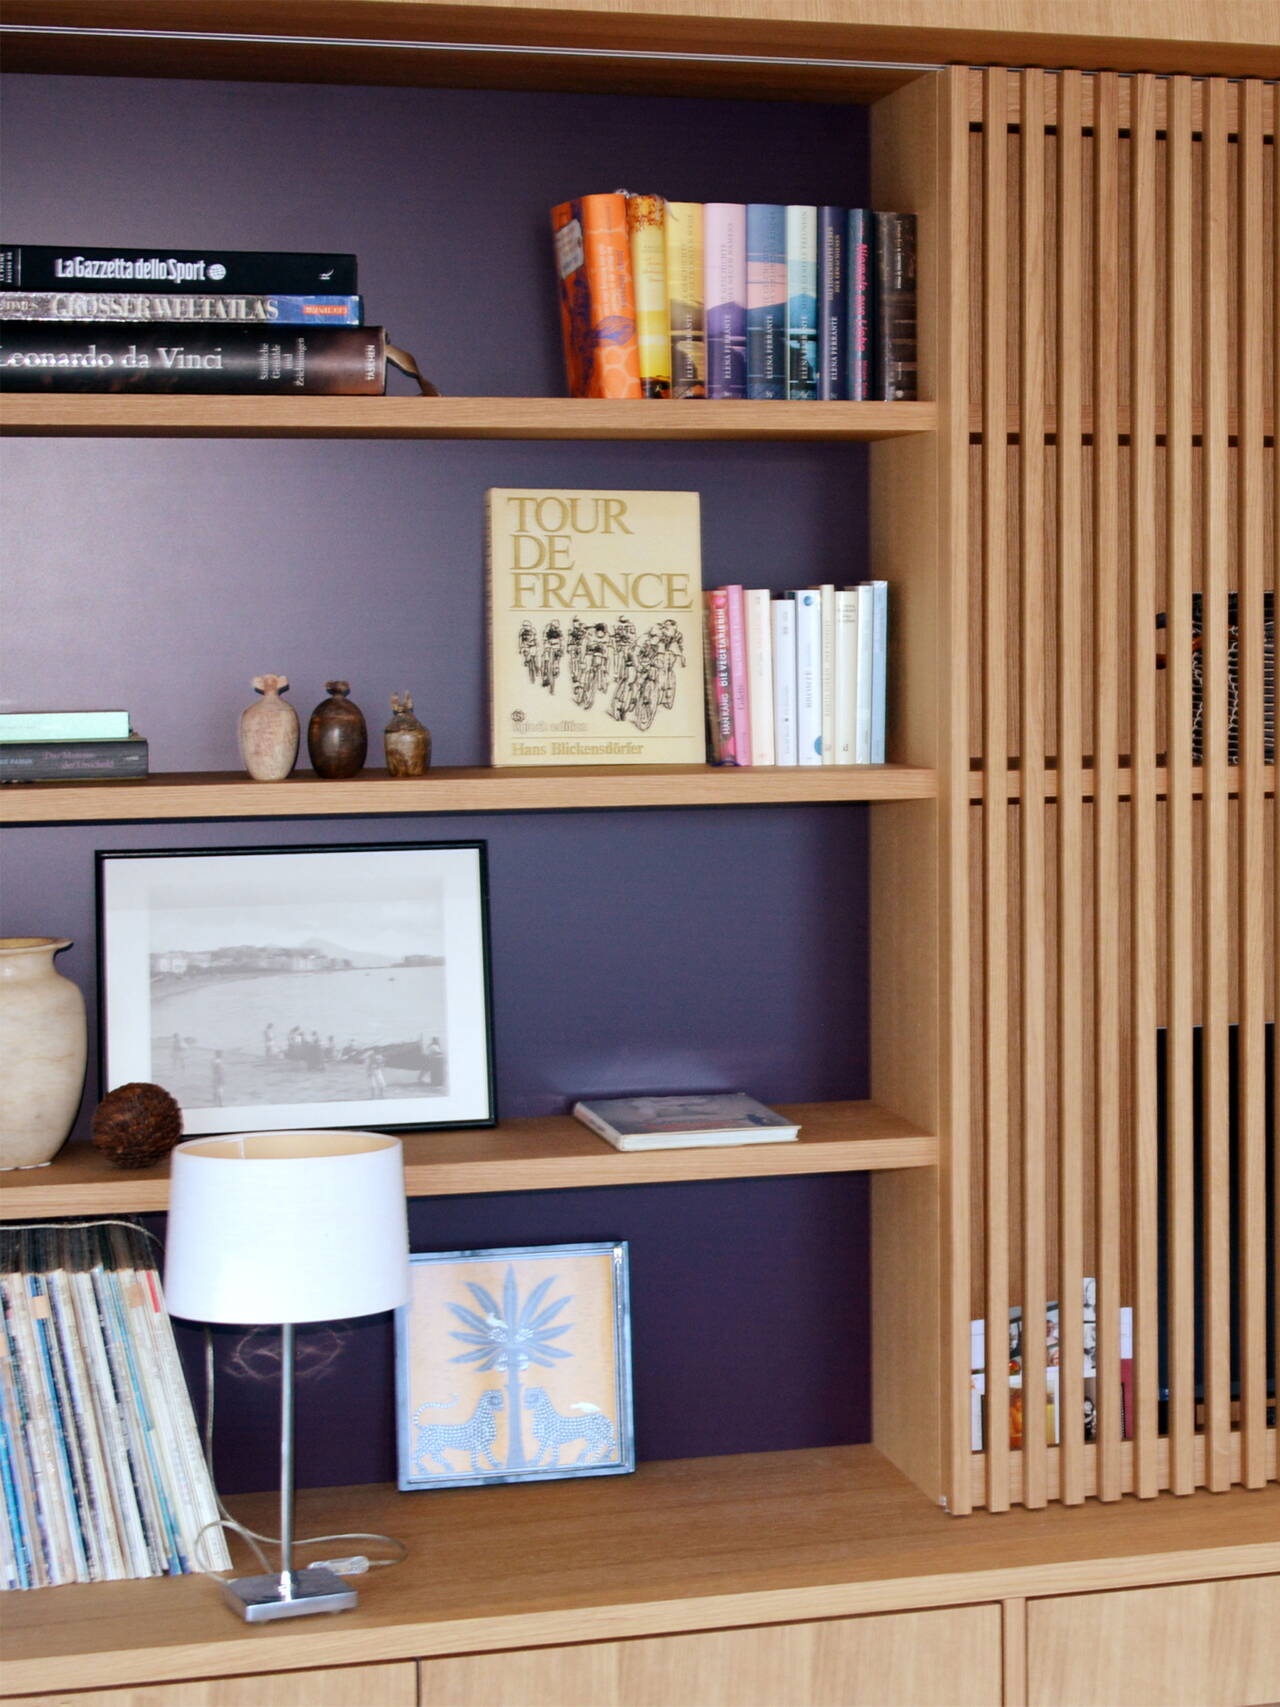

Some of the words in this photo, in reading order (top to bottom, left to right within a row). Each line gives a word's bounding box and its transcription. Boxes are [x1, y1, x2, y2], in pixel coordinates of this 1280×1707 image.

[855, 242, 868, 291] Niemals
[51, 294, 150, 318] GROSSER
[151, 297, 279, 320] WELTATLAS
[856, 294, 867, 315] aus
[684, 313, 693, 353] FERRANTE
[723, 314, 732, 353] FERRANTE
[764, 314, 774, 353] FERRANTE
[800, 315, 808, 354] FERRANTE
[830, 316, 839, 355] FERRANTE
[855, 318, 868, 352] Liebe
[121, 345, 150, 369] da
[156, 346, 224, 369] Vinci
[366, 344, 375, 381] TASCHEN
[685, 354, 693, 379] ELENA
[724, 354, 732, 379] ELENA
[765, 354, 774, 379] ELENA
[800, 355, 808, 379] ELENA
[831, 356, 839, 380] ELENA
[508, 497, 633, 535] TOUR
[511, 535, 576, 571] DE
[510, 573, 695, 609] FRANCE
[717, 608, 728, 670] VEGETARIERIN
[719, 672, 728, 687] DIE
[720, 692, 729, 716] KANG
[721, 716, 730, 735] HAN
[511, 742, 547, 756] Hans
[551, 741, 644, 755] Blickensdörfer
